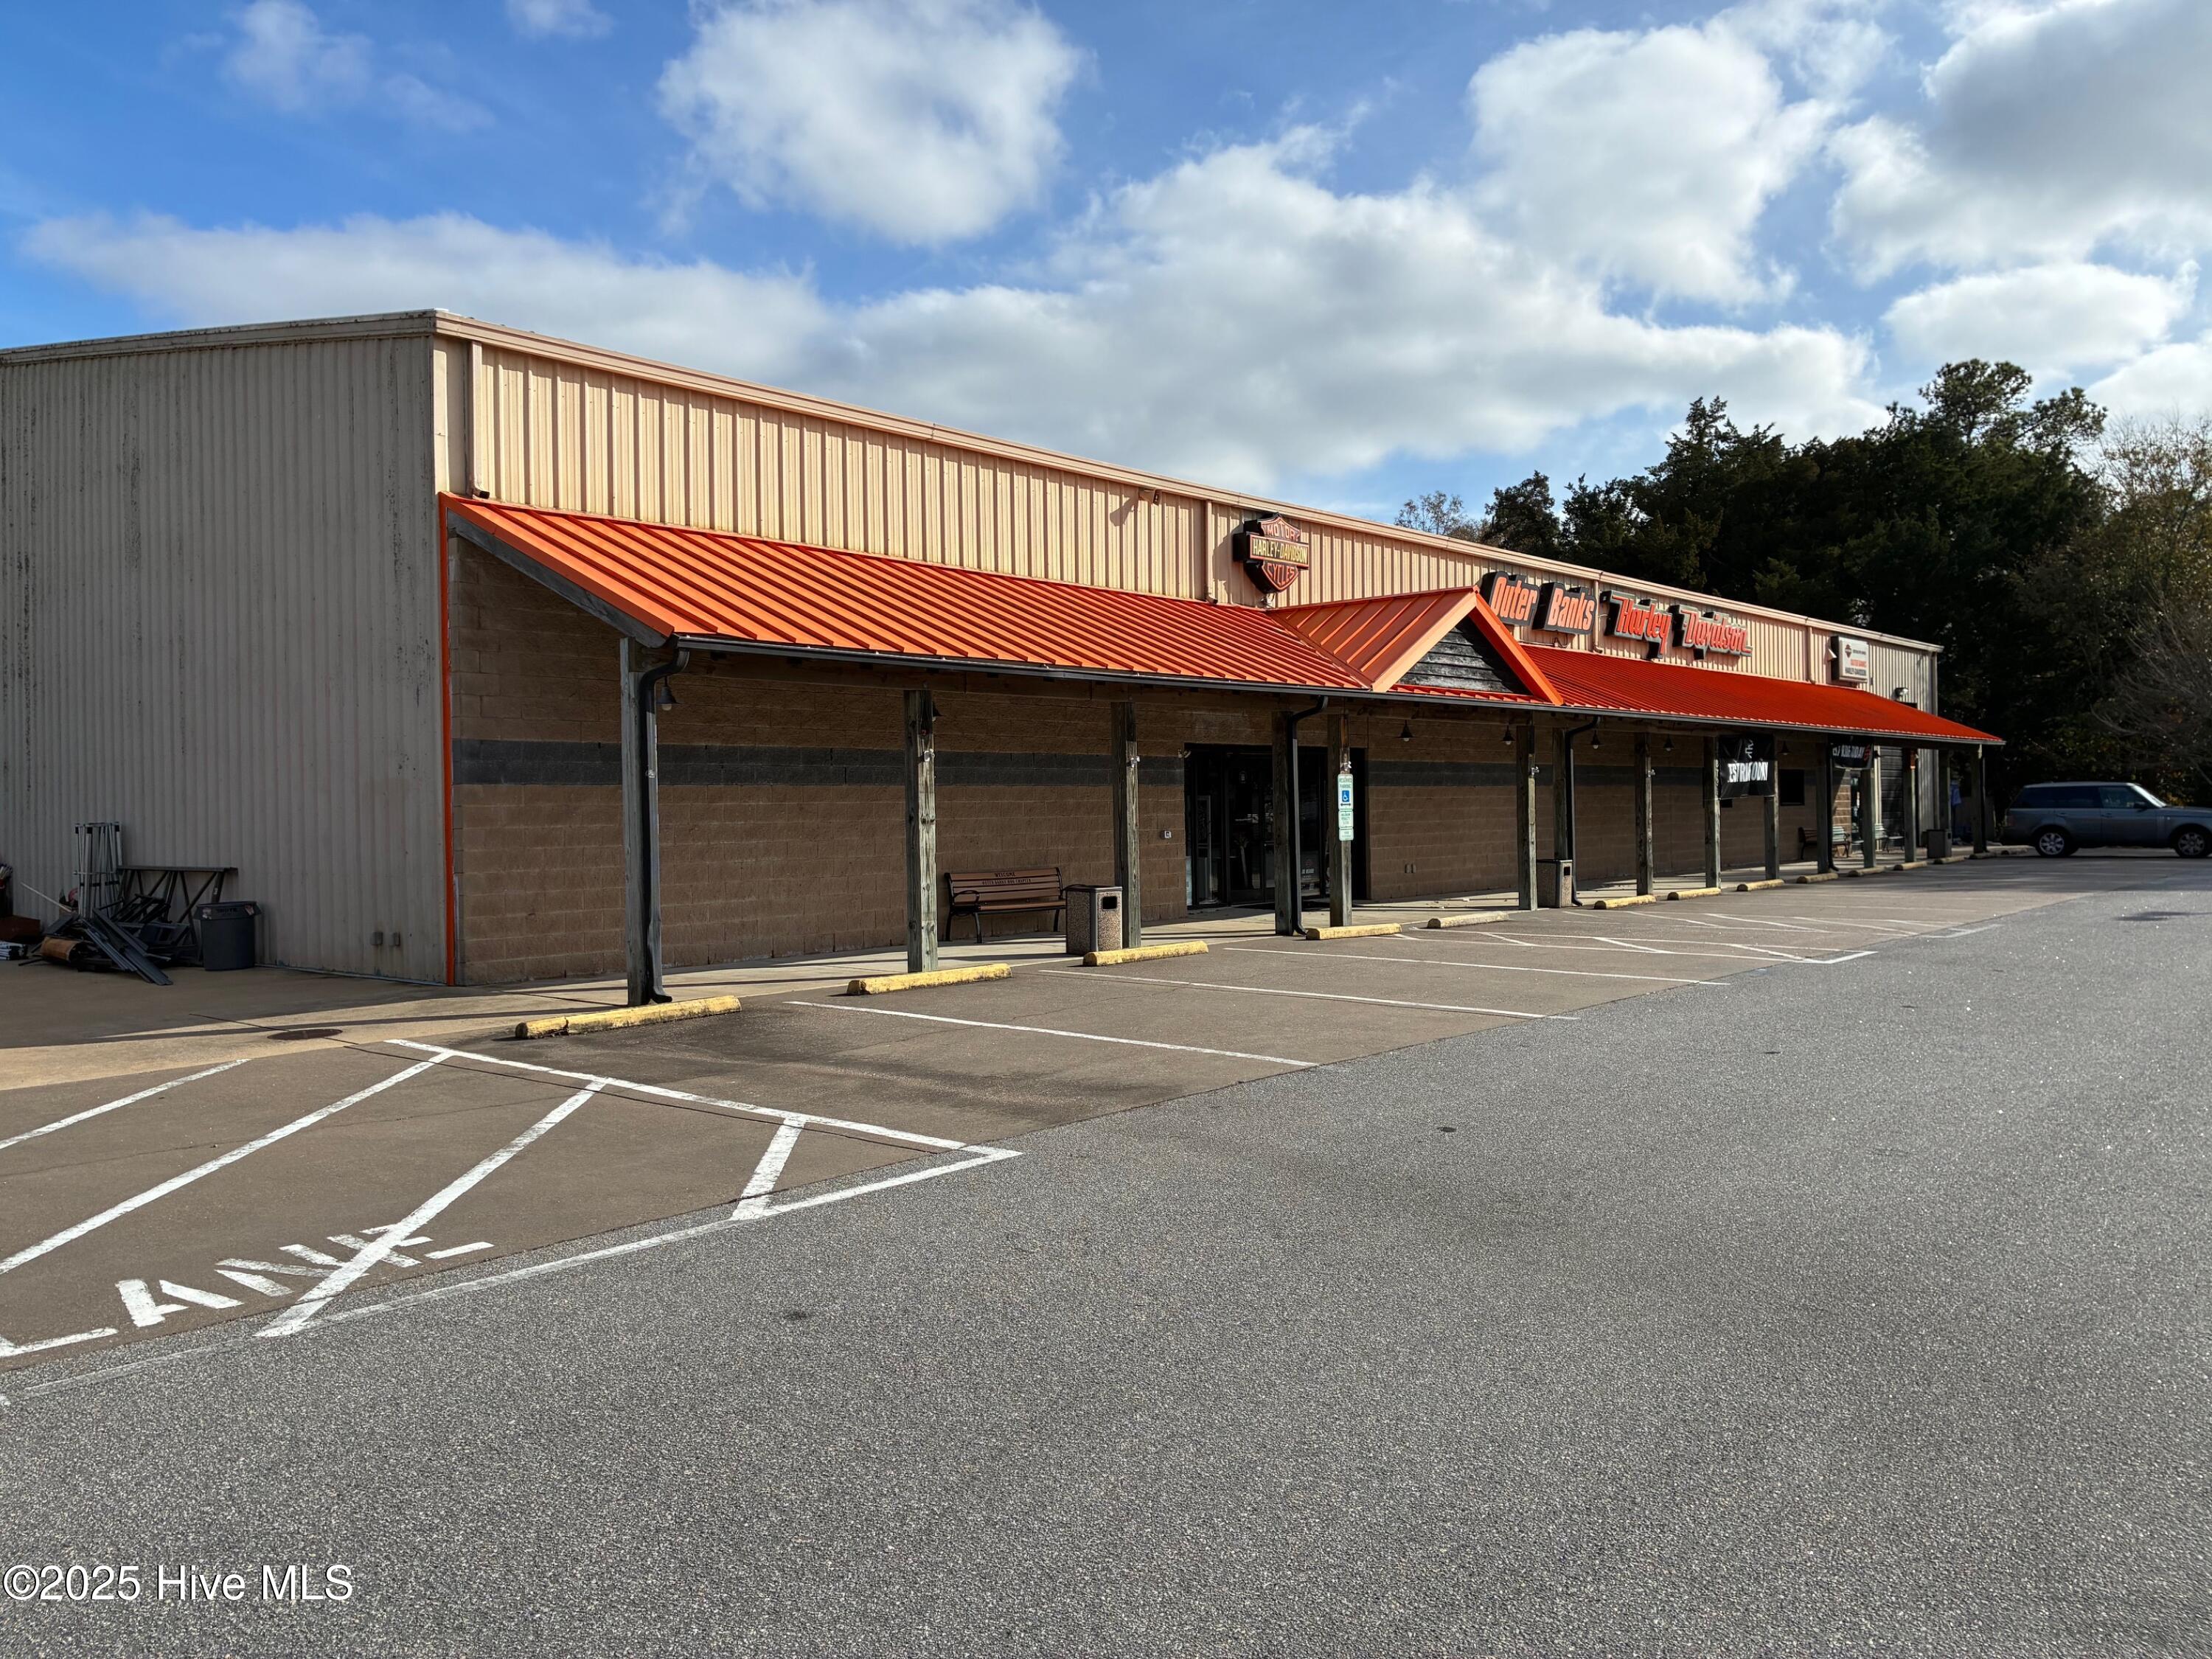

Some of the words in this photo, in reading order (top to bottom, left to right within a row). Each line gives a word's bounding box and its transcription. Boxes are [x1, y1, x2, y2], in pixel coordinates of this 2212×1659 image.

[1267, 522, 1296, 540] MOTOR
[1253, 538, 1307, 563] HARLEY-DAVIDSON
[1267, 563, 1295, 585] CYCLES
[1491, 577, 1538, 621] Outer
[1548, 588, 1595, 630] Banks
[1613, 594, 1672, 655] Harley
